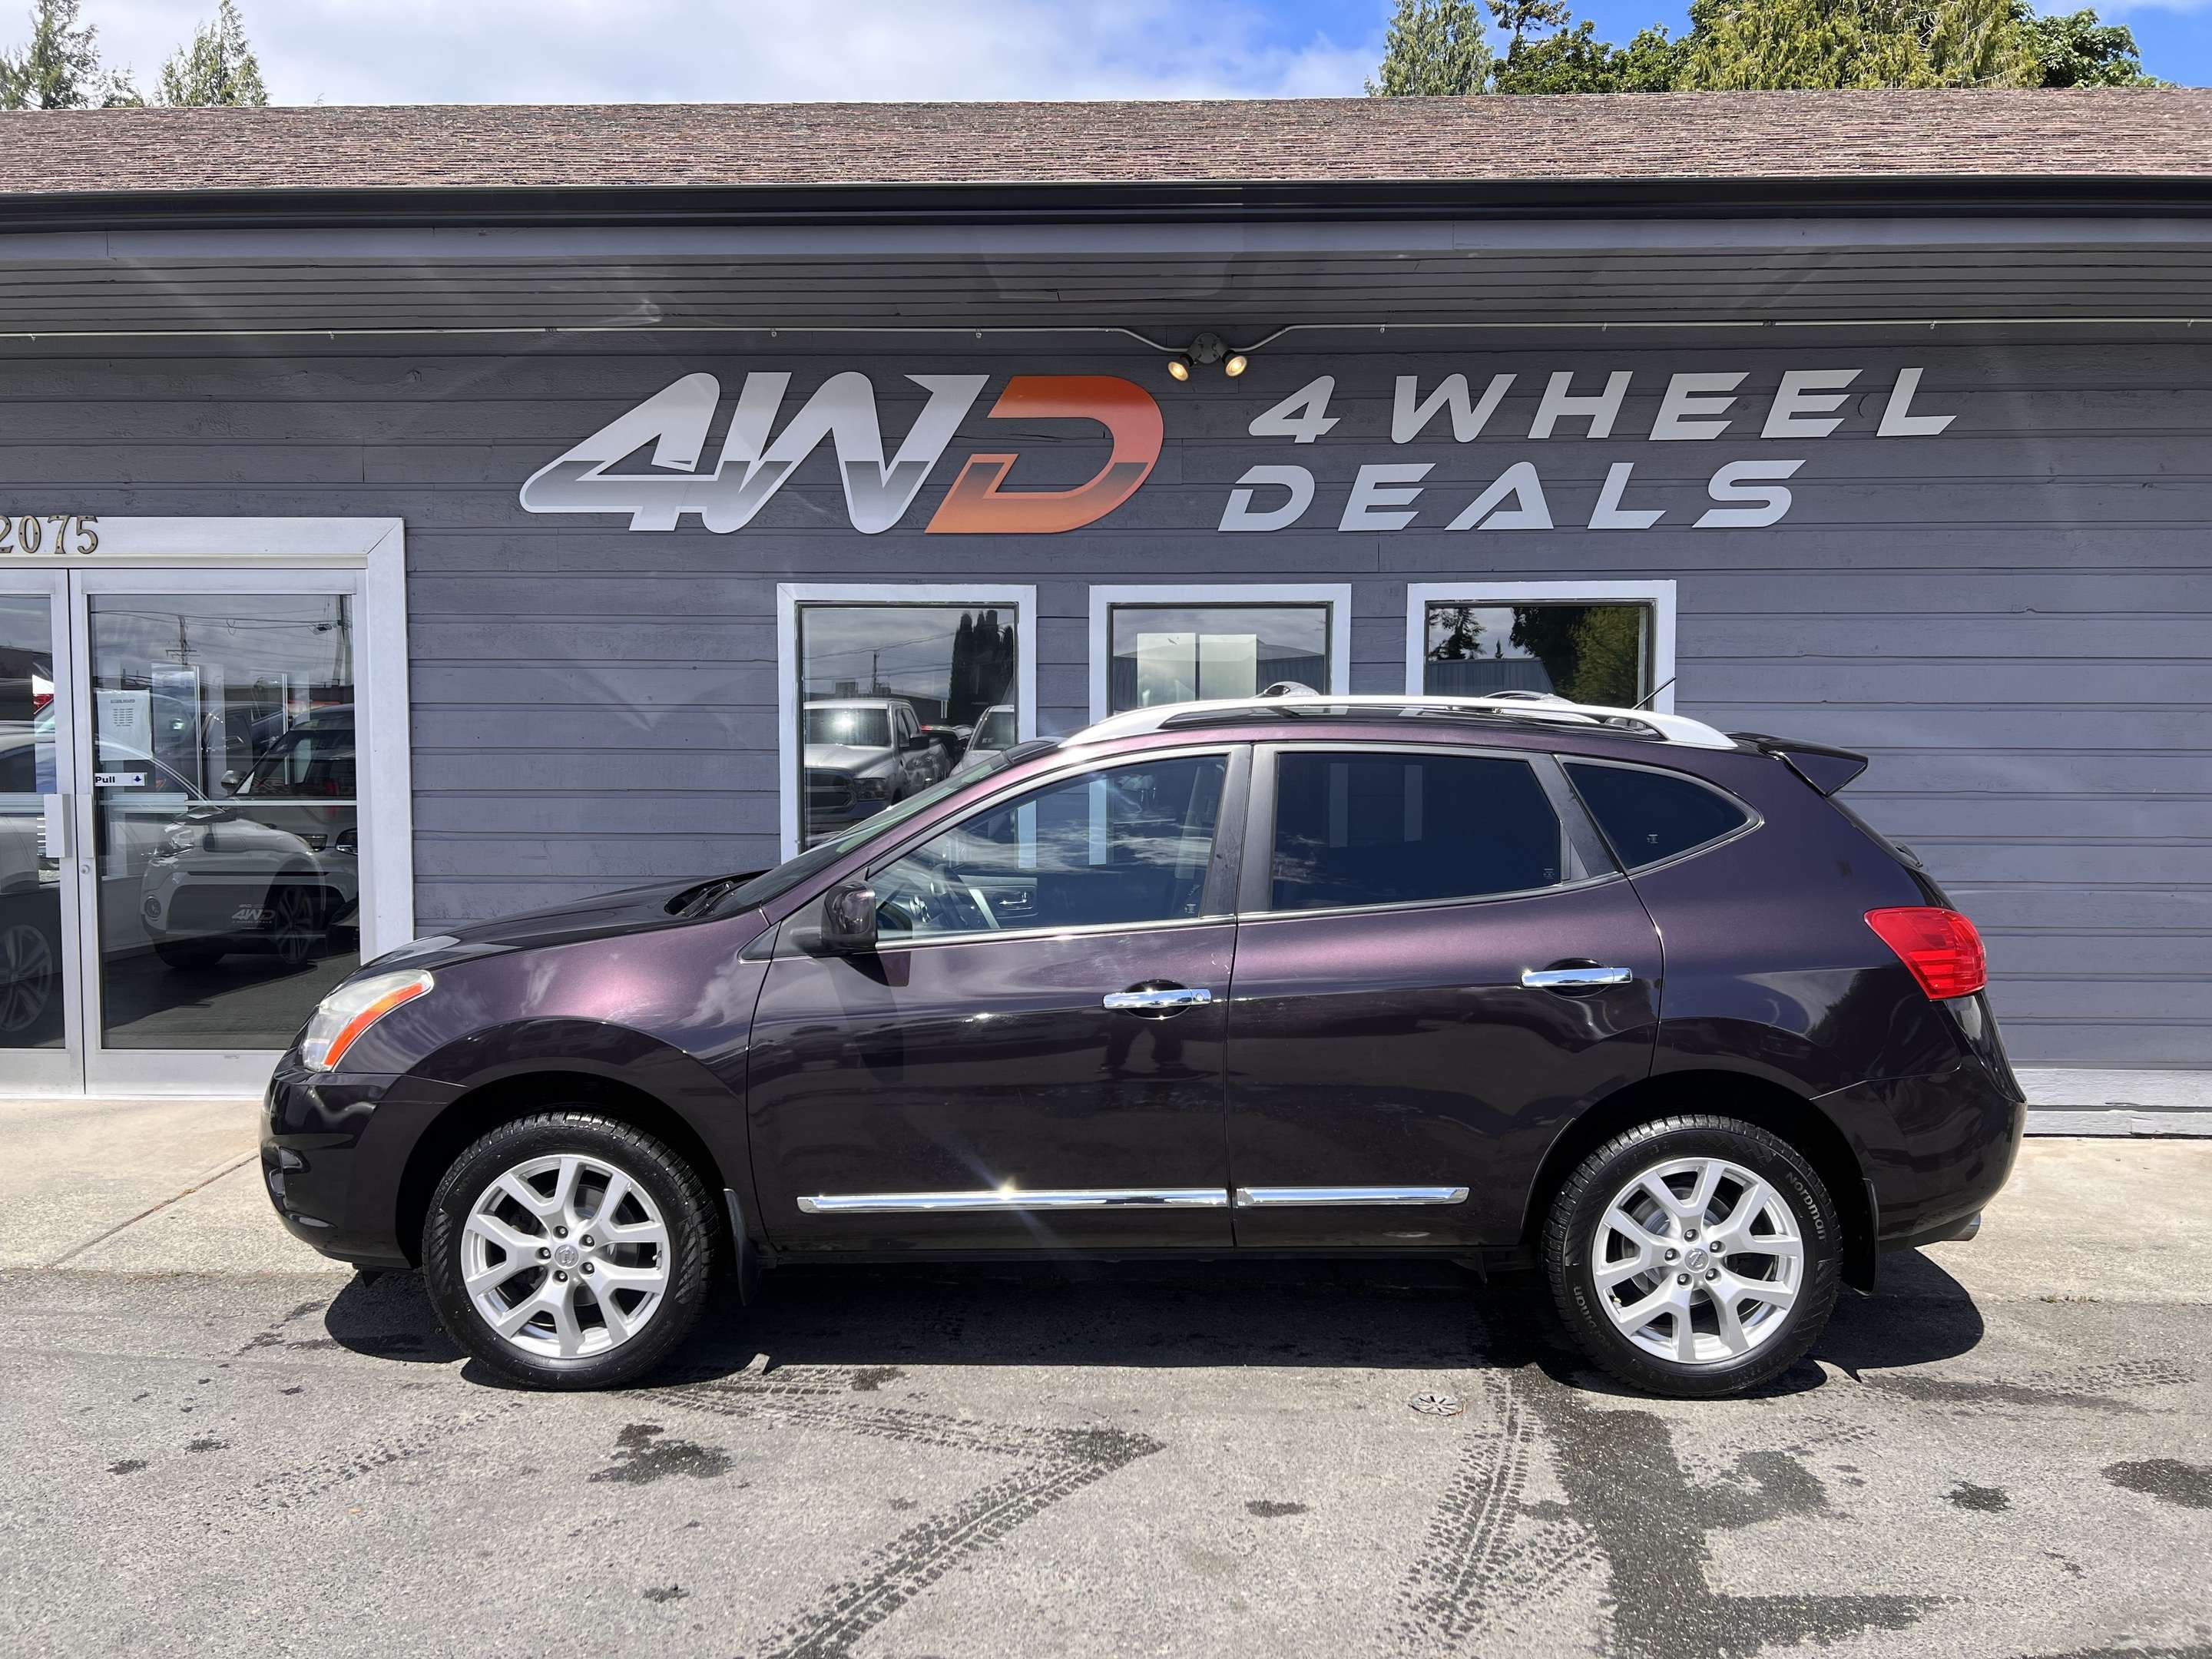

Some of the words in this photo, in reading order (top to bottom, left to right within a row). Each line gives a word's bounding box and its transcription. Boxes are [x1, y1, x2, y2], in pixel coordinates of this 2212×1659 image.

[1248, 375, 1341, 443] 4
[1392, 367, 1958, 444] WHEEL
[519, 371, 1165, 535] 4WD
[1217, 459, 1806, 531] DEALS
[0, 515, 98, 554] 2075
